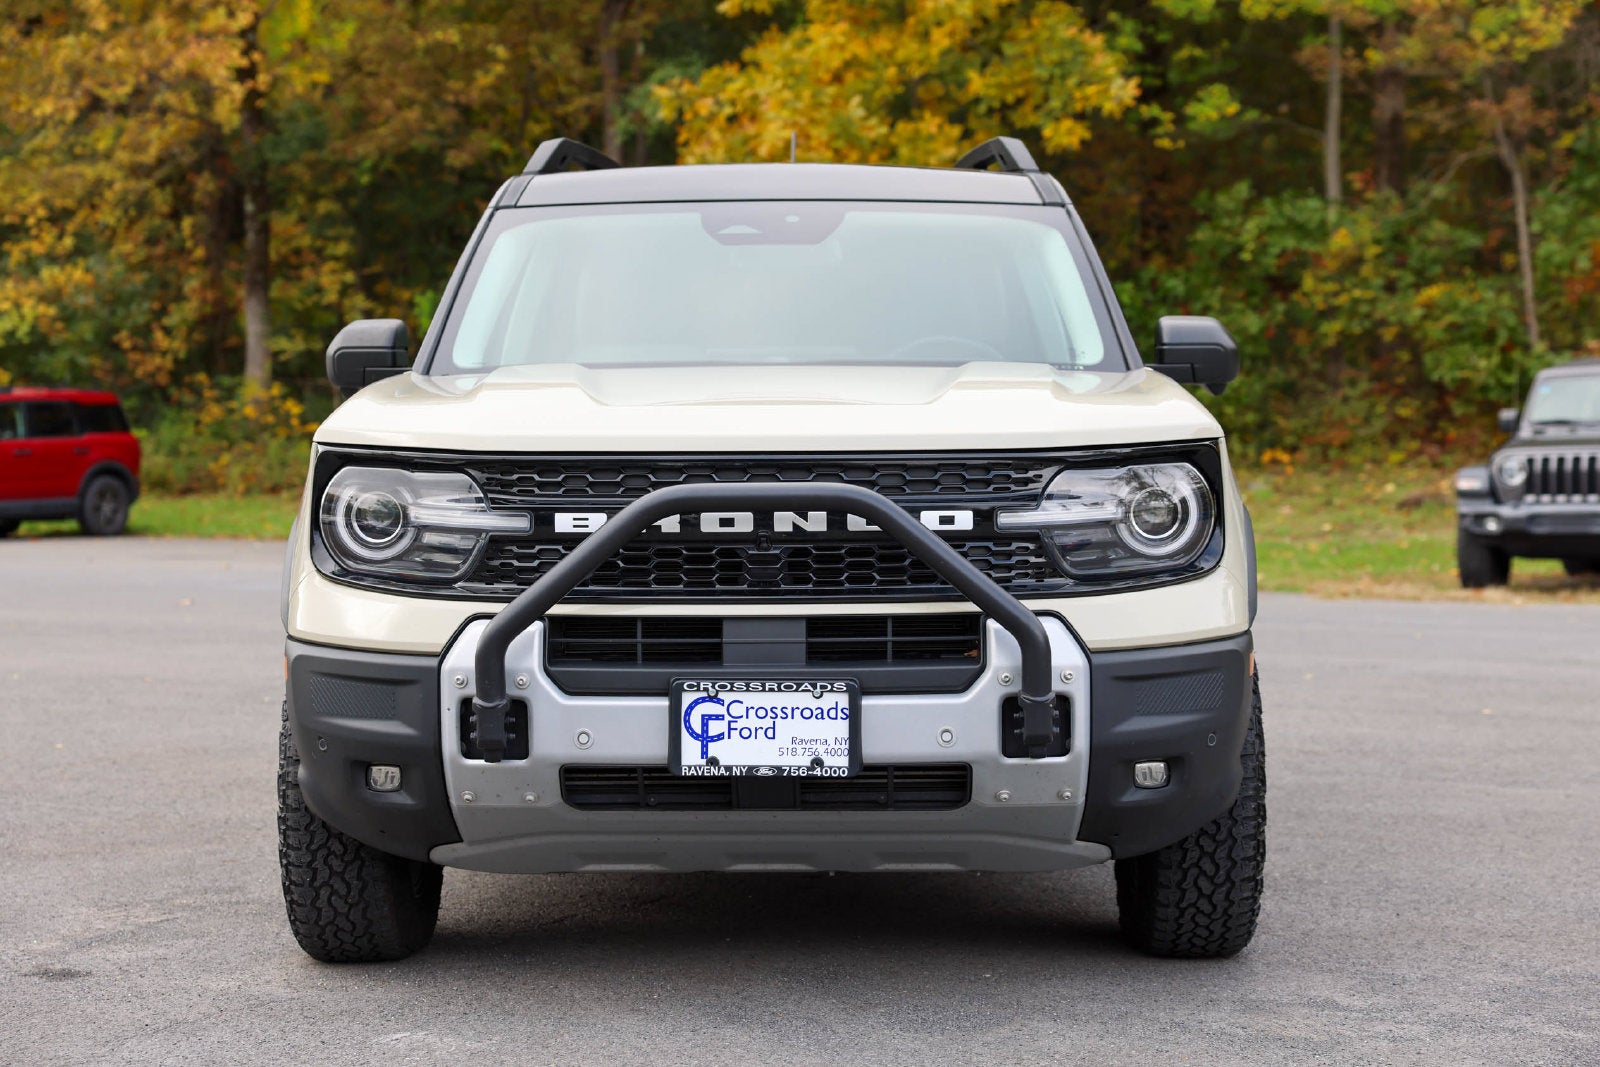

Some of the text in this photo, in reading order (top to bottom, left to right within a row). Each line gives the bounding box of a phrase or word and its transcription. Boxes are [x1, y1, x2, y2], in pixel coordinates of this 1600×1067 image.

[683, 682, 847, 692] CROSSROADS
[726, 700, 849, 720] Crossroads
[727, 720, 776, 740] Ford
[791, 736, 850, 747] Ravena, NY
[778, 747, 850, 757] 518.756.4000
[681, 766, 748, 777] RAVENA, NY
[781, 766, 848, 777] 756-4000
